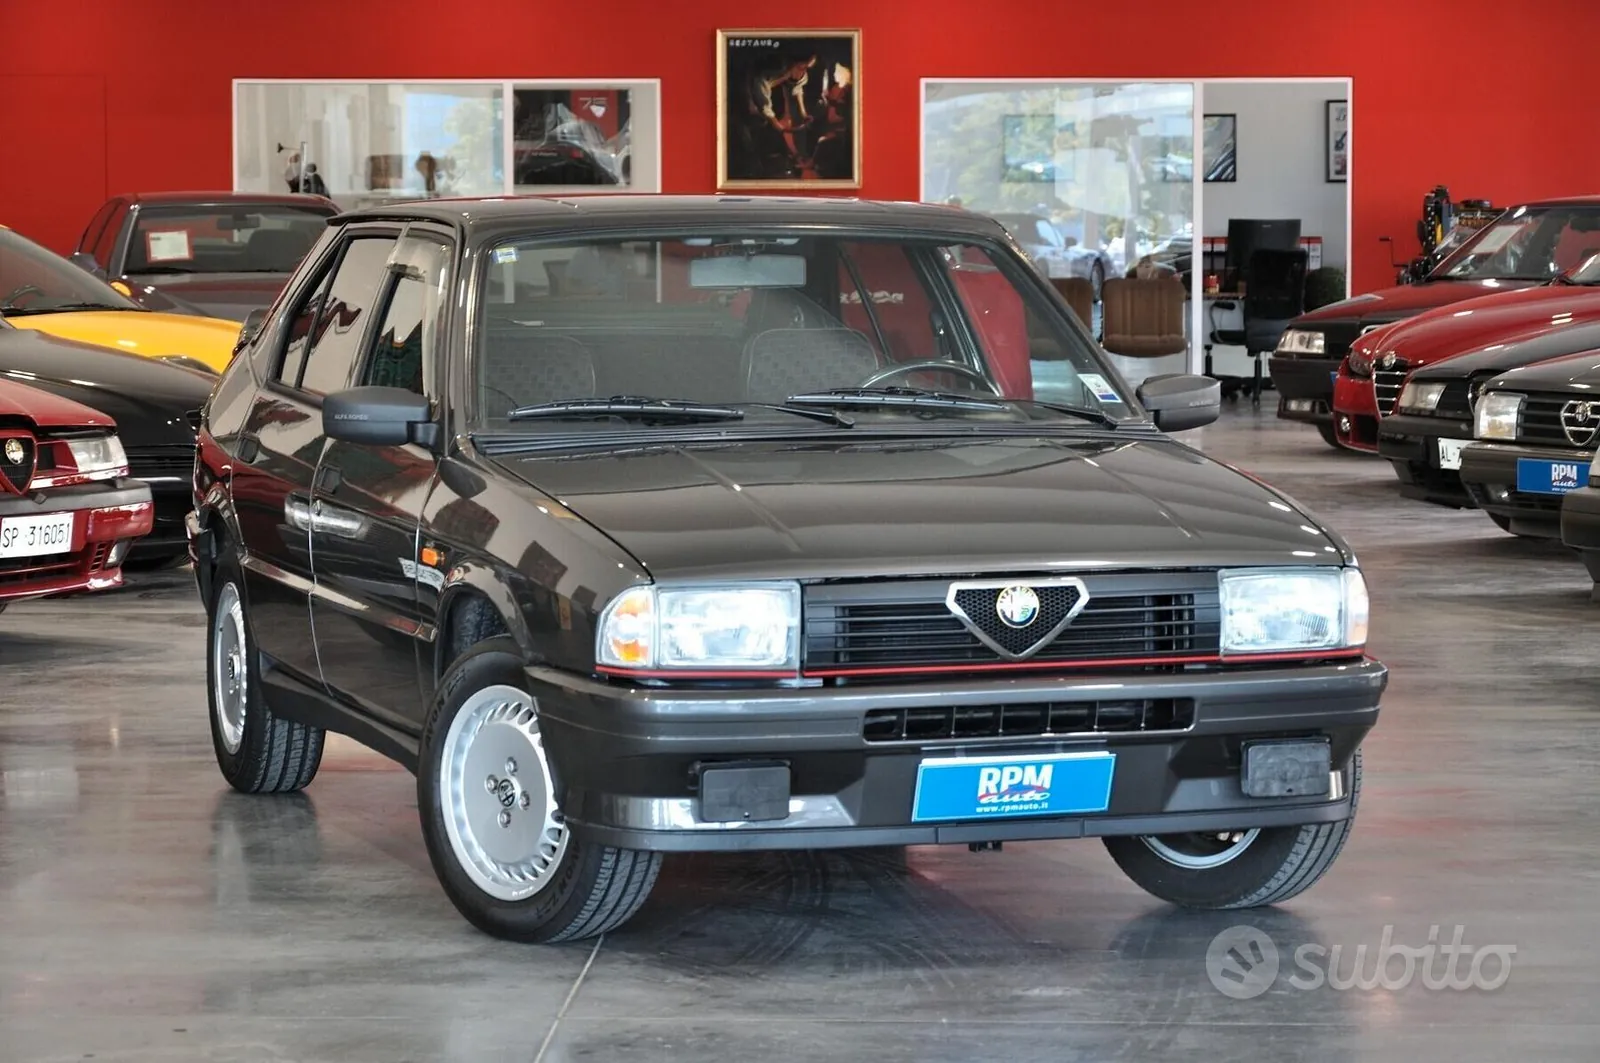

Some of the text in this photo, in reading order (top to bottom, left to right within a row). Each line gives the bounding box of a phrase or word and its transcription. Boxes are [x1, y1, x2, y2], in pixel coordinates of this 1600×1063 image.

[1551, 463, 1577, 481] RPM
[1552, 480, 1578, 488] auto
[2, 522, 70, 548] SP 316051
[977, 764, 1053, 800] RPM
[979, 789, 1051, 804] auto
[976, 802, 1048, 813] www.rpmauto.it
